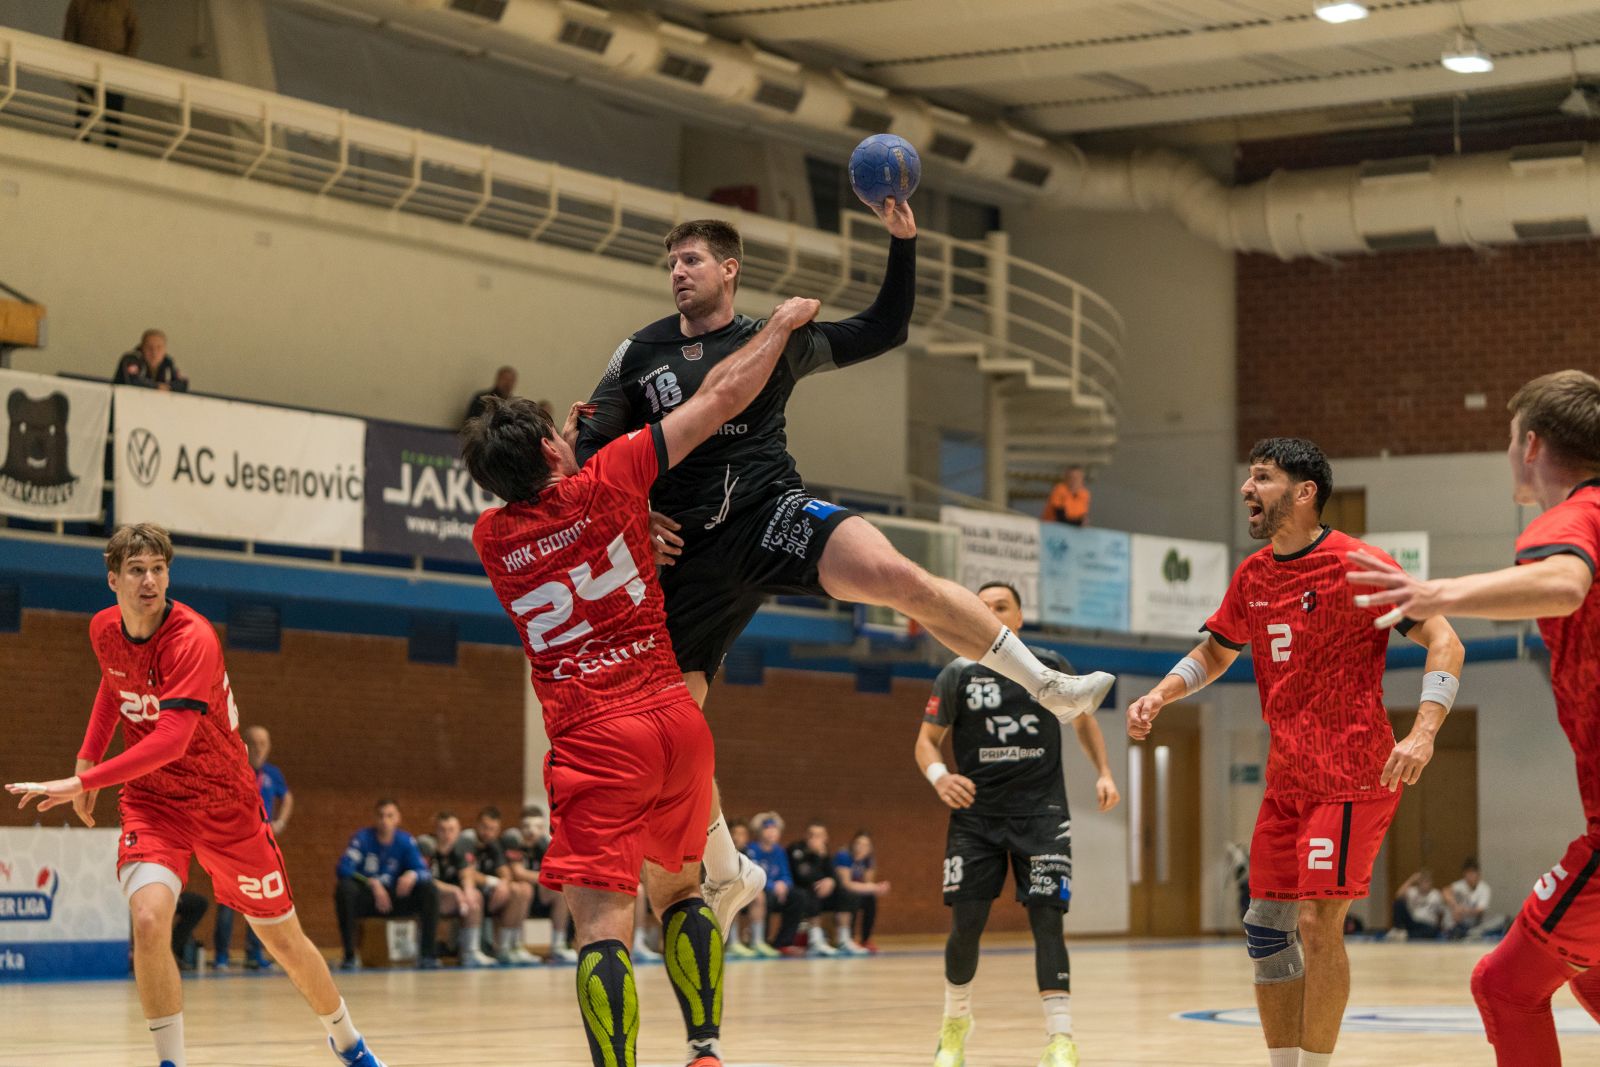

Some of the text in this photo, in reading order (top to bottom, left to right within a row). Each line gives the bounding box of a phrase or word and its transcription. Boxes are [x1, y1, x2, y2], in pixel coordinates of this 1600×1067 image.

[638, 364, 670, 387] Kempa
[645, 371, 683, 414] 18
[714, 424, 748, 435] IRO
[173, 445, 362, 501] AC Jesenović
[782, 523, 802, 554] biro
[795, 526, 814, 559] plus
[502, 544, 537, 573] HRK
[511, 533, 647, 653] 24
[1267, 624, 1292, 662] 2
[119, 690, 160, 723] 20
[966, 683, 1002, 710] 33
[980, 748, 1019, 761] PRIMA
[1308, 837, 1334, 870] 2
[237, 870, 284, 899] 20
[17, 895, 48, 917] LIGA
